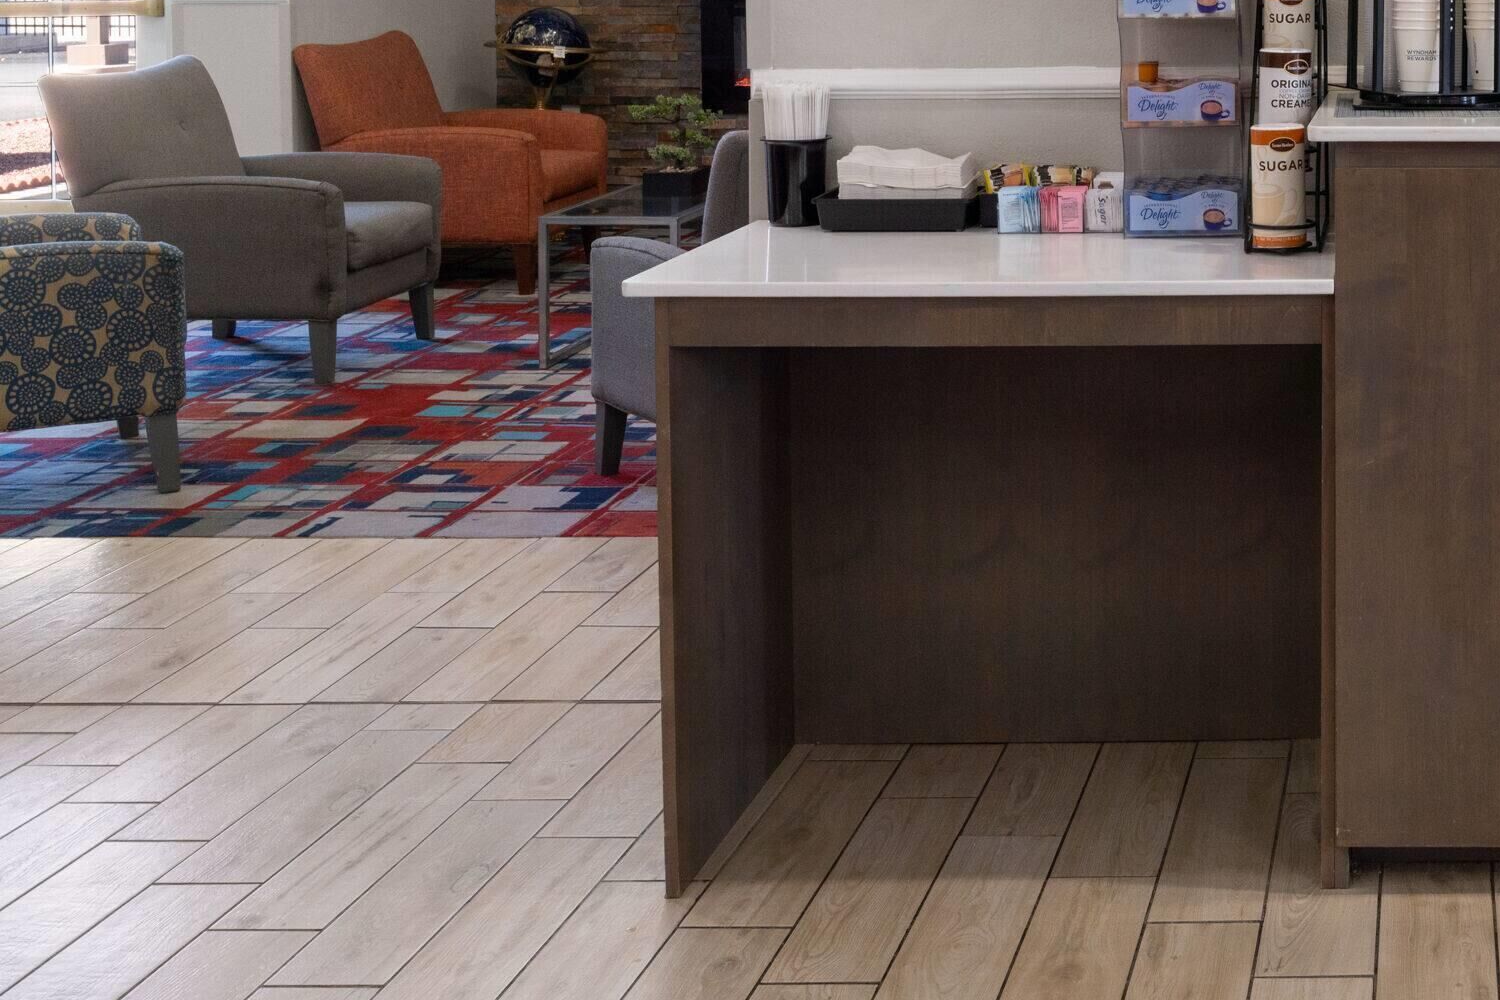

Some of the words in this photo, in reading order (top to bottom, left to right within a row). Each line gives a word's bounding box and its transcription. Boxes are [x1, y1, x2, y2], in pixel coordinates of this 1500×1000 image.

[1269, 13, 1312, 24] SUGAR
[1271, 79, 1312, 88] ORIGINA
[1271, 99, 1311, 108] CREAME
[1138, 99, 1178, 121] Delight
[1259, 160, 1303, 172] SUGAR
[1140, 207, 1181, 229] Delight
